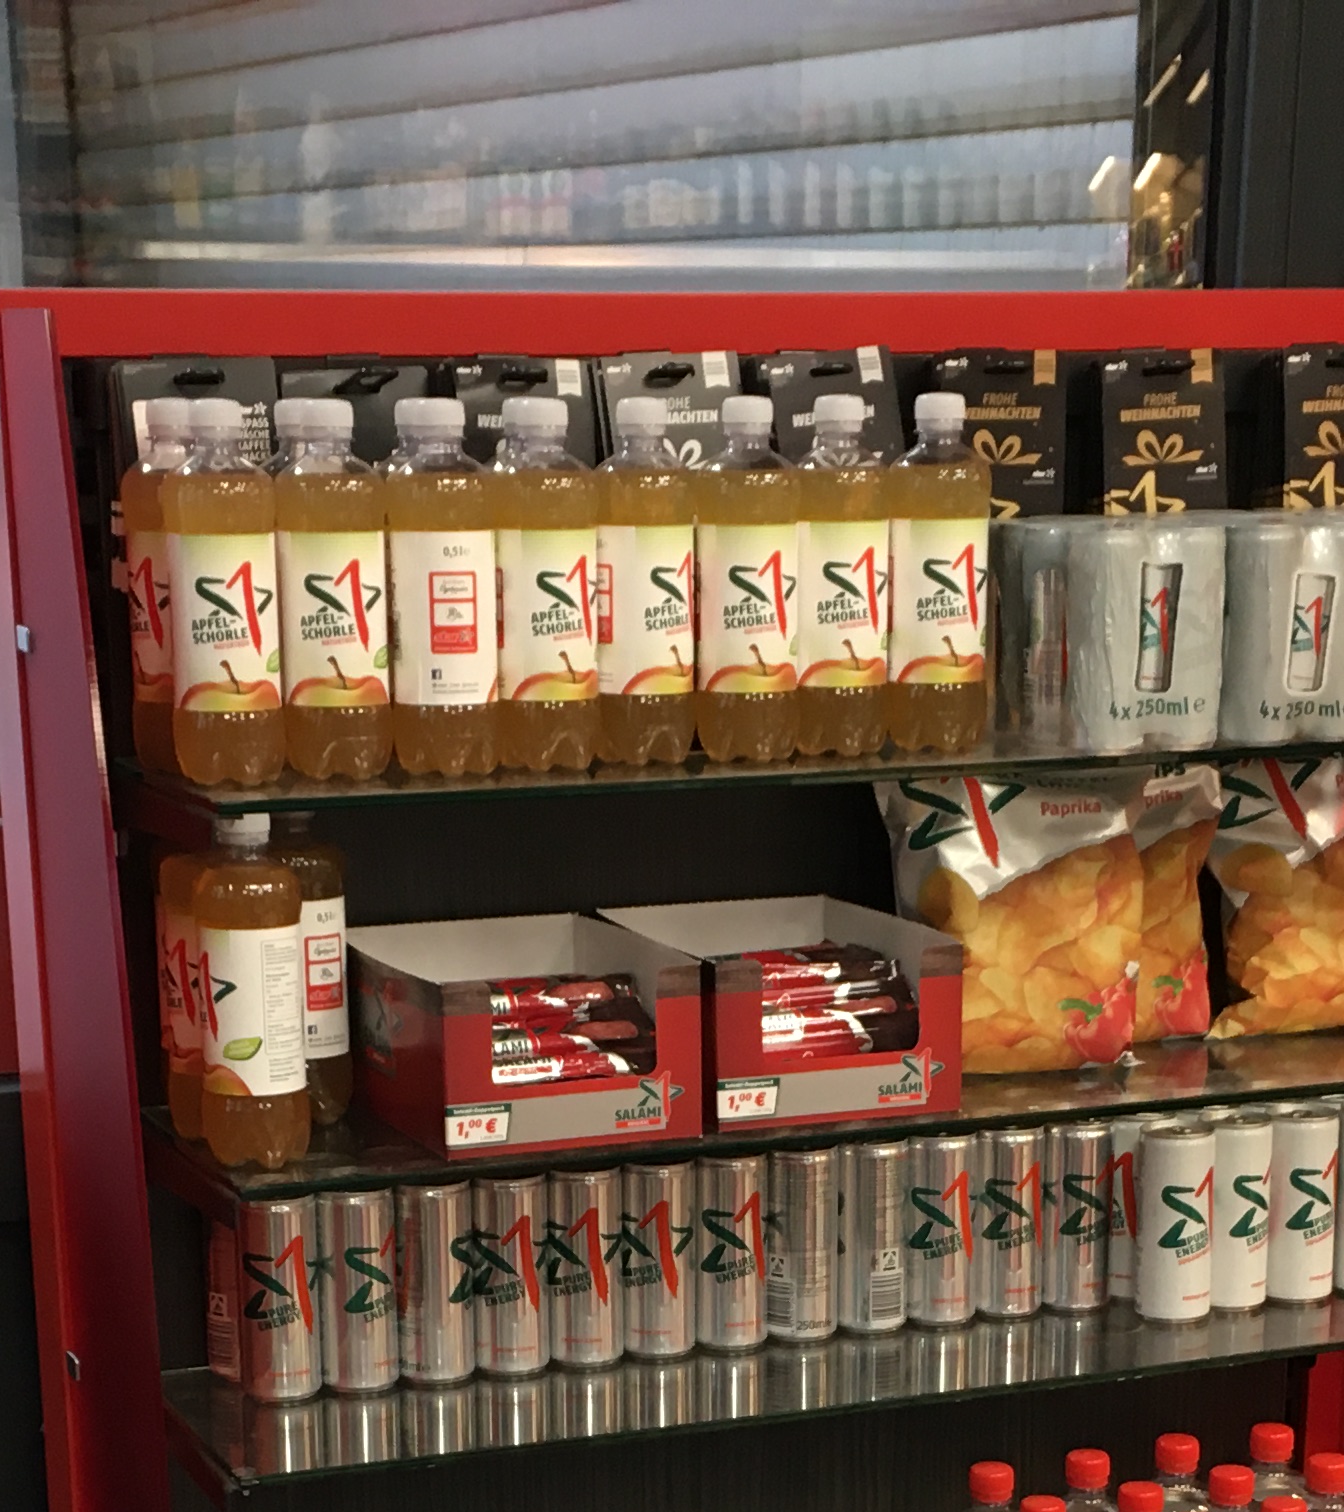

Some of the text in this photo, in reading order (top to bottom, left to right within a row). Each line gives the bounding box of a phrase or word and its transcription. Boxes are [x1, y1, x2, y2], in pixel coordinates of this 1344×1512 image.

[1145, 789, 1184, 809] prika
[1040, 801, 1102, 818] Paprika
[878, 1082, 923, 1096] SALAMI
[615, 1106, 662, 1122] SALAMI
